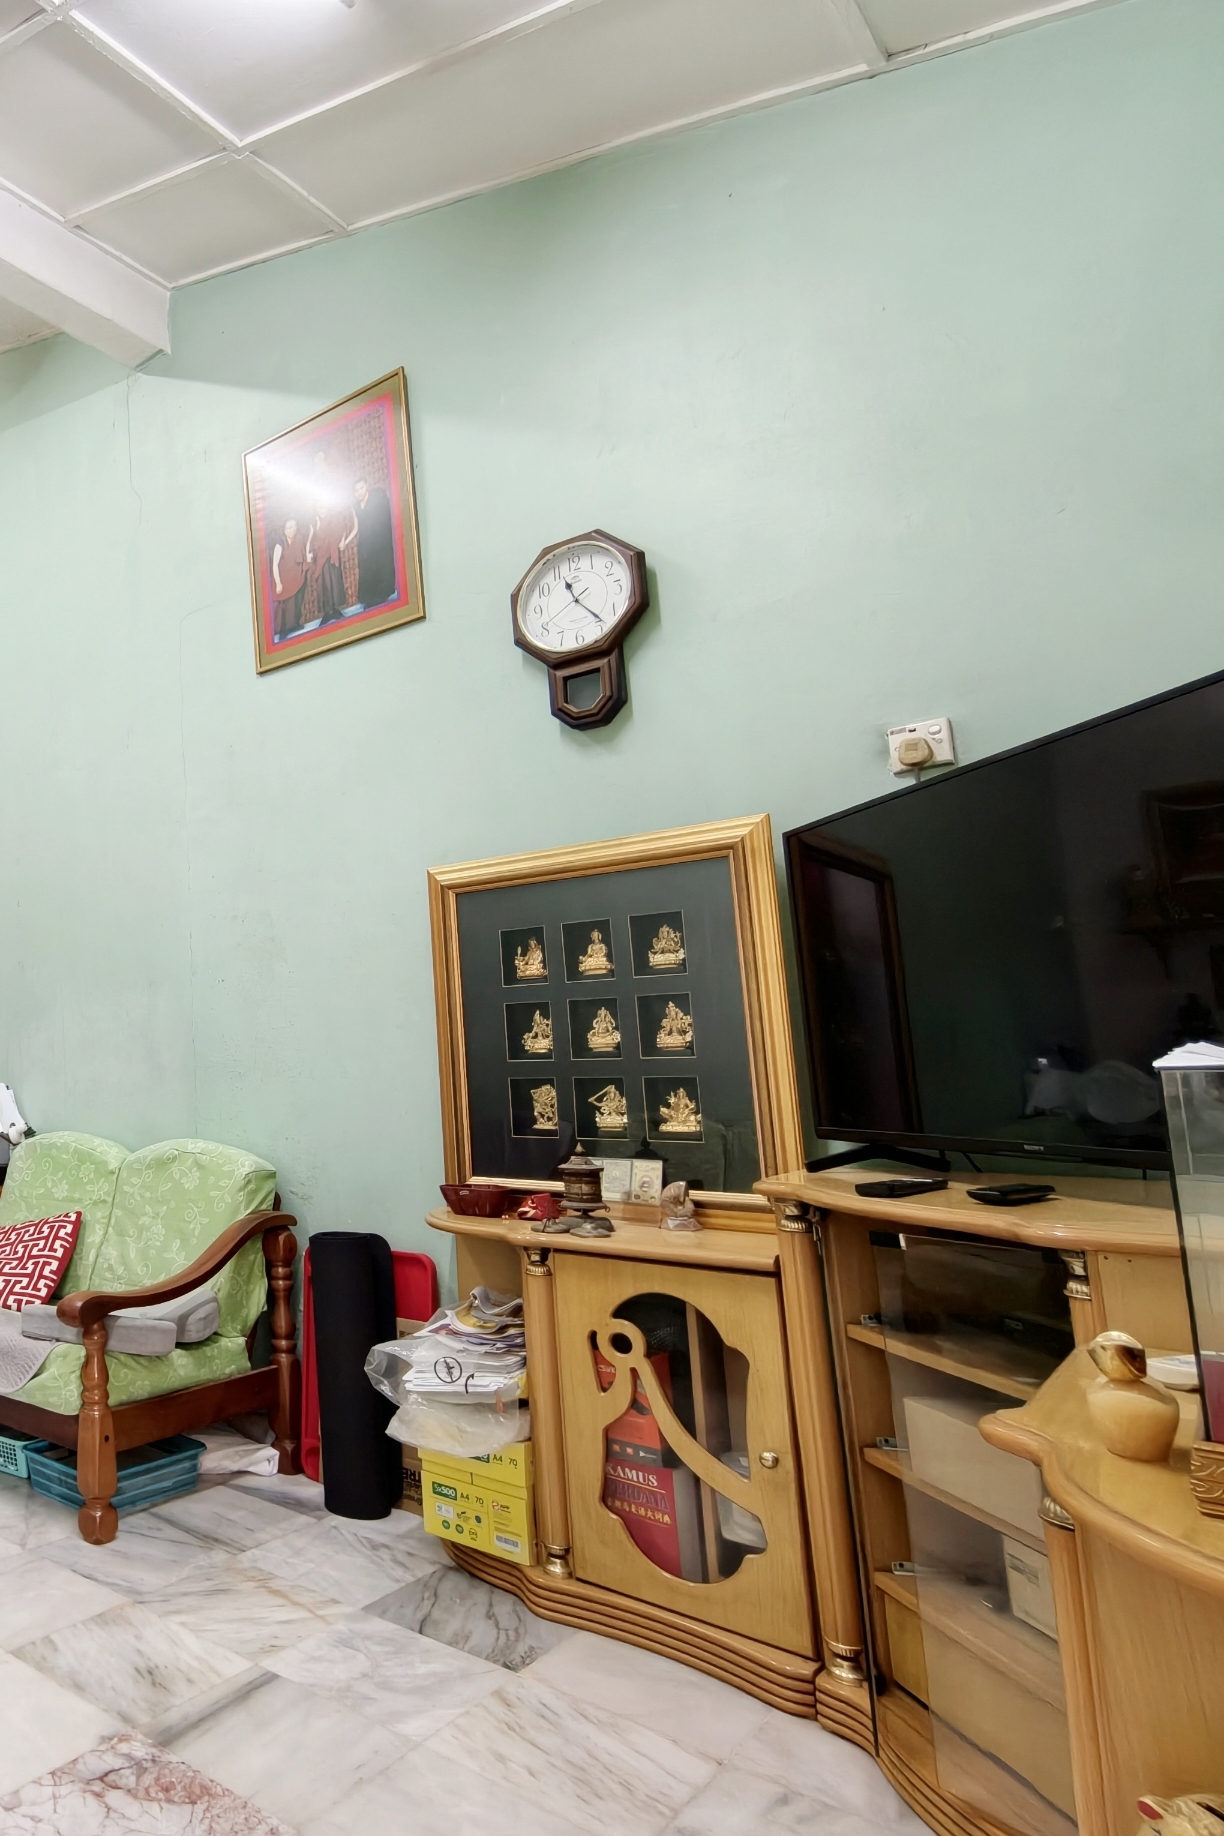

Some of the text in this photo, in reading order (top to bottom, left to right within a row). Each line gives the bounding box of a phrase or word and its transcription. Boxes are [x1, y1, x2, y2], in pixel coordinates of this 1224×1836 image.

[567, 555, 581, 573] 12
[604, 560, 614, 577] 2
[553, 565, 561, 582] 11
[538, 582, 550, 599] 10
[613, 578, 623, 596] 3
[533, 603, 543, 620] 9
[540, 621, 550, 638] 8
[594, 619, 604, 637] 5
[556, 630, 565, 647] 7
[575, 629, 585, 646] 6
[492, 1453, 503, 1463] A4
[606, 1462, 658, 1487] KAMUS
[459, 1492, 470, 1501] A4
[474, 1496, 484, 1505] 70
